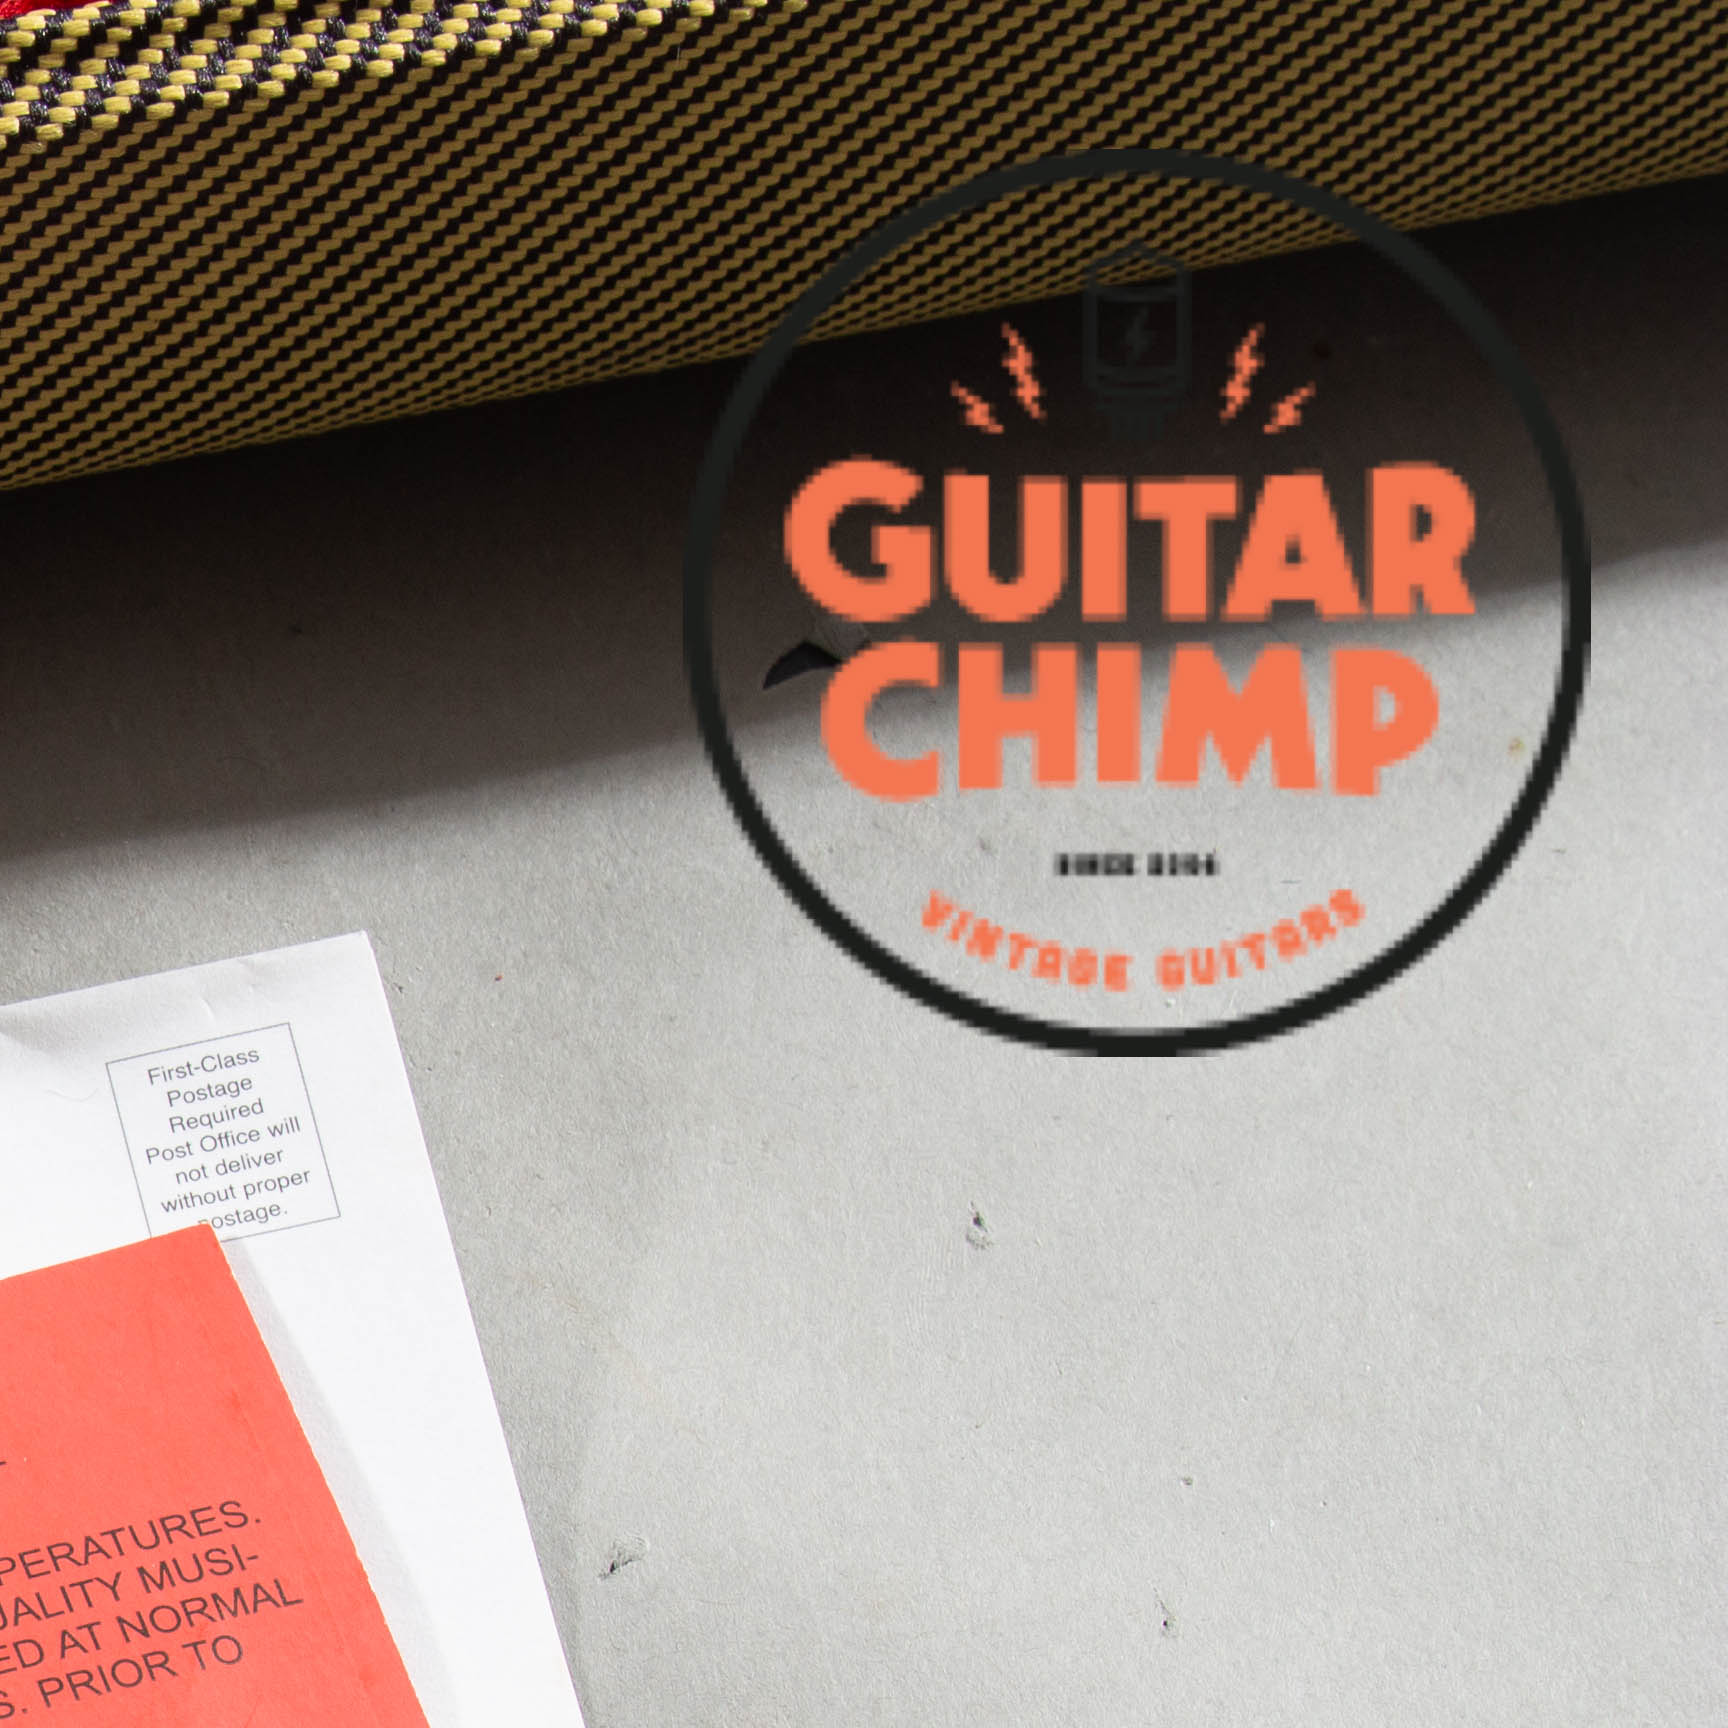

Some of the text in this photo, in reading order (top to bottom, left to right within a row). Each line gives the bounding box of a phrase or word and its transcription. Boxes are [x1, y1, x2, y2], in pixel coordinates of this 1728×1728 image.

[147, 1049, 260, 1085] First-Class
[167, 1077, 252, 1107] Postage
[169, 1098, 264, 1133] Required
[146, 1116, 301, 1164] Post Office will
[176, 1149, 284, 1184] not deliver
[161, 1170, 310, 1213] without proper
[137, 1544, 259, 1594] MUSI-
[59, 1623, 103, 1659] AT
[117, 1578, 304, 1639] NORMAL
[38, 1652, 176, 1708] PRIOR
[182, 1635, 244, 1670] TO
